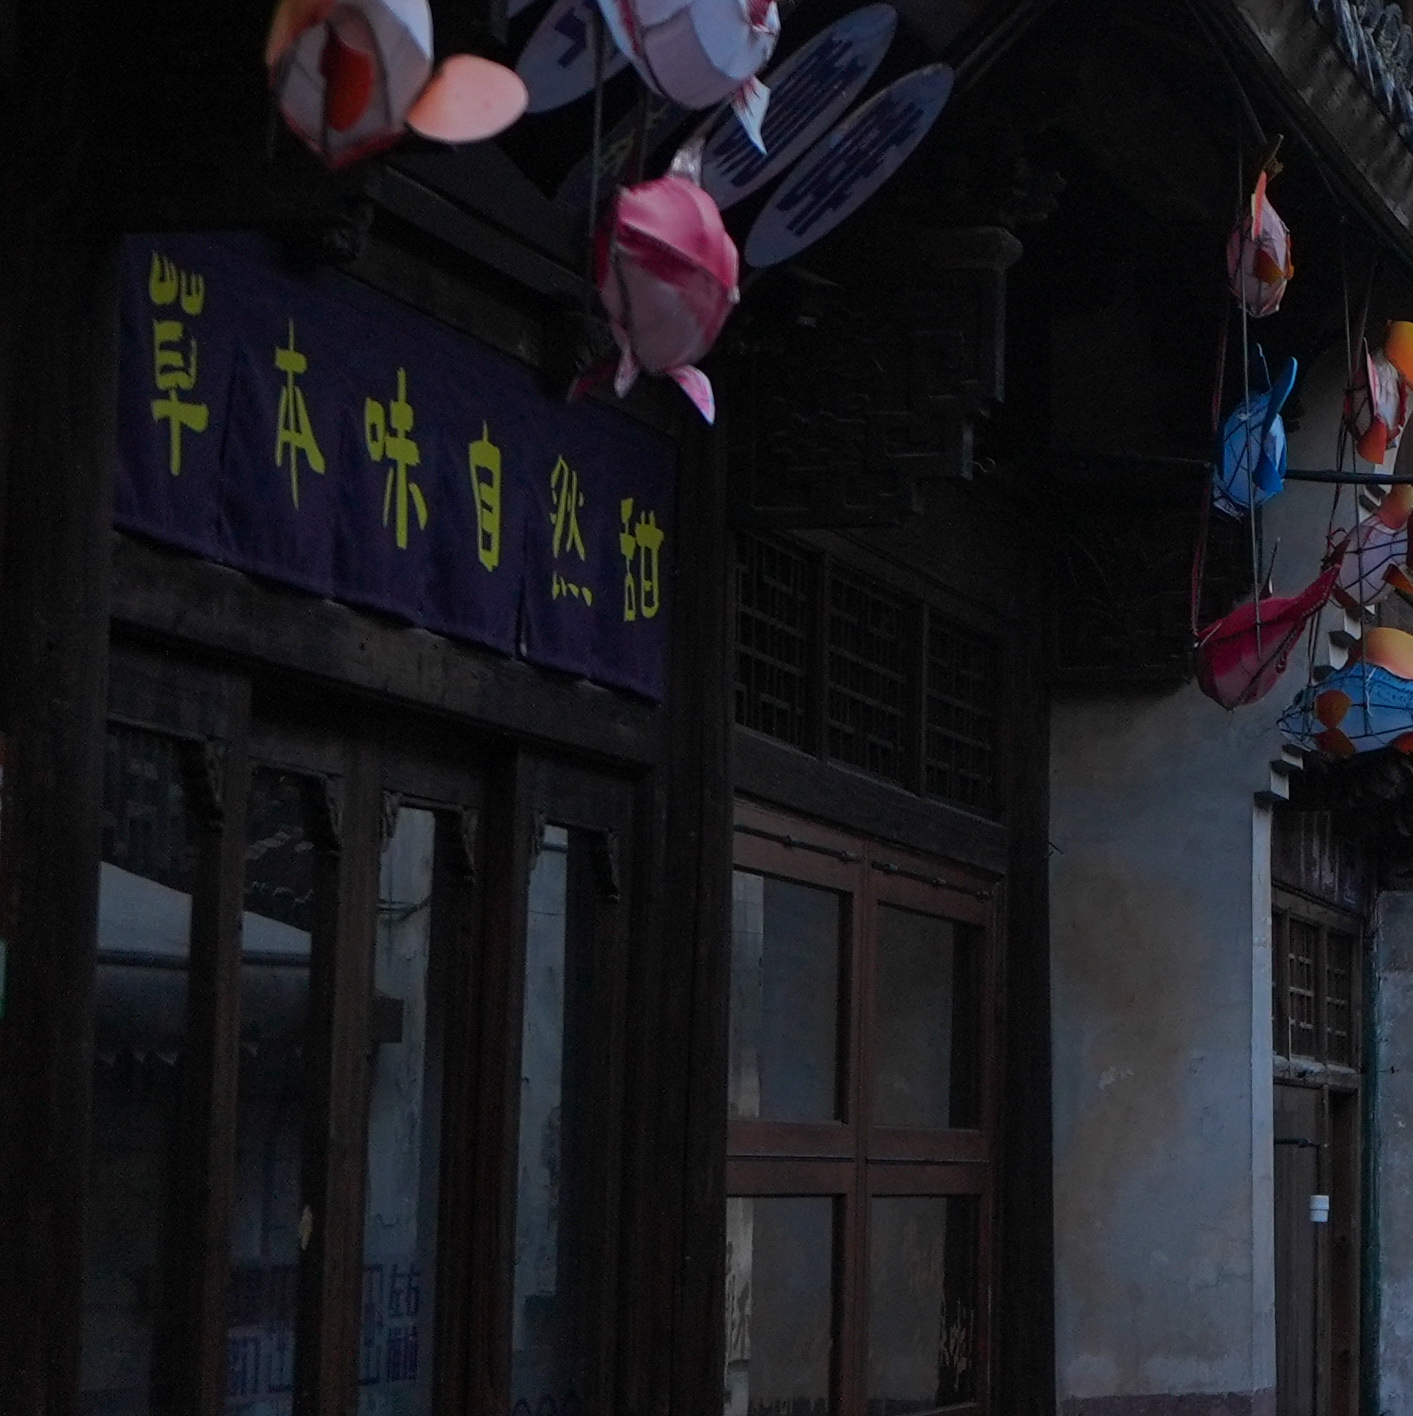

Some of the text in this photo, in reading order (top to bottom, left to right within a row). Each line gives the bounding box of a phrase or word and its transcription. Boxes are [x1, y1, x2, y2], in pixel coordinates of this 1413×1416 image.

[149, 251, 664, 621] 草本味自然甜
